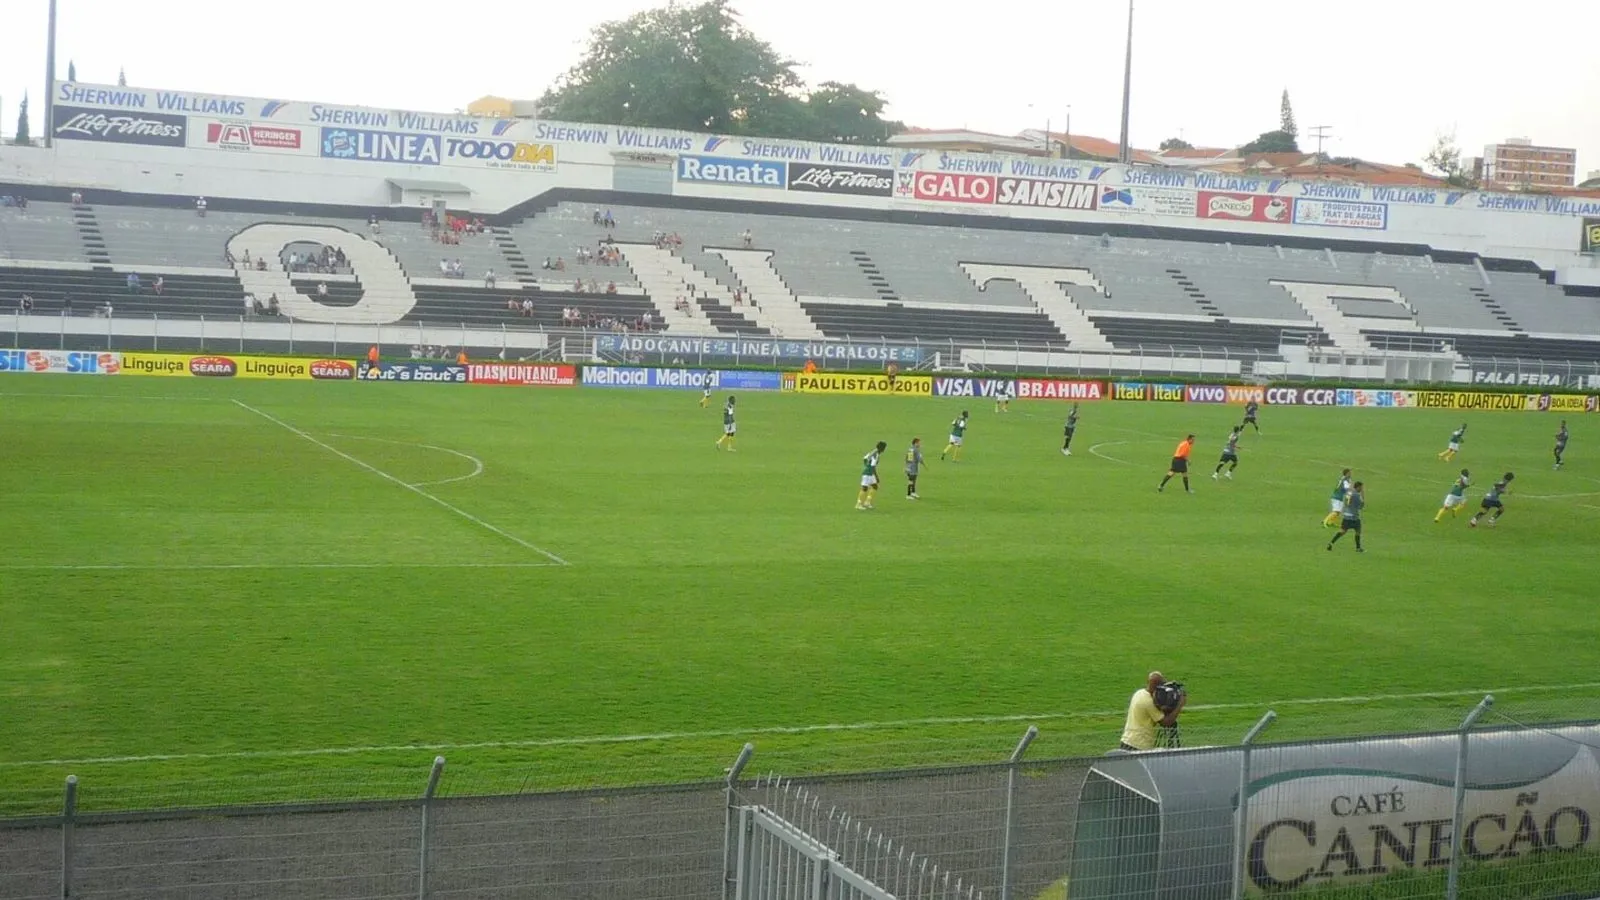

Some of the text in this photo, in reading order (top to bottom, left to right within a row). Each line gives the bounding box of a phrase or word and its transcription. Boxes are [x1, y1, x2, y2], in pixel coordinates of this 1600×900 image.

[59, 84, 245, 115] SHERWIN WILLIAMS
[310, 105, 479, 134] SHERWIN WILLIAMS
[254, 130, 296, 140] HERINGER
[535, 123, 692, 150] SHERWIN WILLIAMS
[358, 132, 439, 162] LINEA
[742, 140, 892, 166] SHERWIN WILLIAMS
[681, 158, 781, 185] Renata
[938, 153, 1080, 179] SHERWIN WILLIAMS
[918, 174, 990, 199] GALO
[1123, 168, 1260, 192] SHERWIN WILLIAMS
[998, 179, 1097, 209] SANSIM
[1300, 183, 1436, 205] SHERWIN WILLIAMS
[1477, 193, 1538, 211] SHERWIN
[731, 342, 781, 356] LINEA
[803, 342, 898, 360] SUCRALOSE
[123, 356, 232, 373] Linguiça SEARA
[245, 361, 350, 377] Linguiça SEARA
[468, 364, 558, 381] TRASMONTANO
[583, 366, 649, 384] Melhoral
[1475, 371, 1560, 386] FALA FERA
[800, 377, 930, 392] PAULISTÃO 2010
[936, 378, 974, 396] VISA
[1019, 382, 1100, 398] BRAHMA
[1116, 382, 1144, 400] Itaú
[1154, 384, 1181, 400] Itaú
[1266, 388, 1296, 404] CCR
[1303, 389, 1334, 405] CCR
[1416, 391, 1527, 409] WEBER QUARTZOLIT
[1331, 786, 1407, 817] CAFÉ
